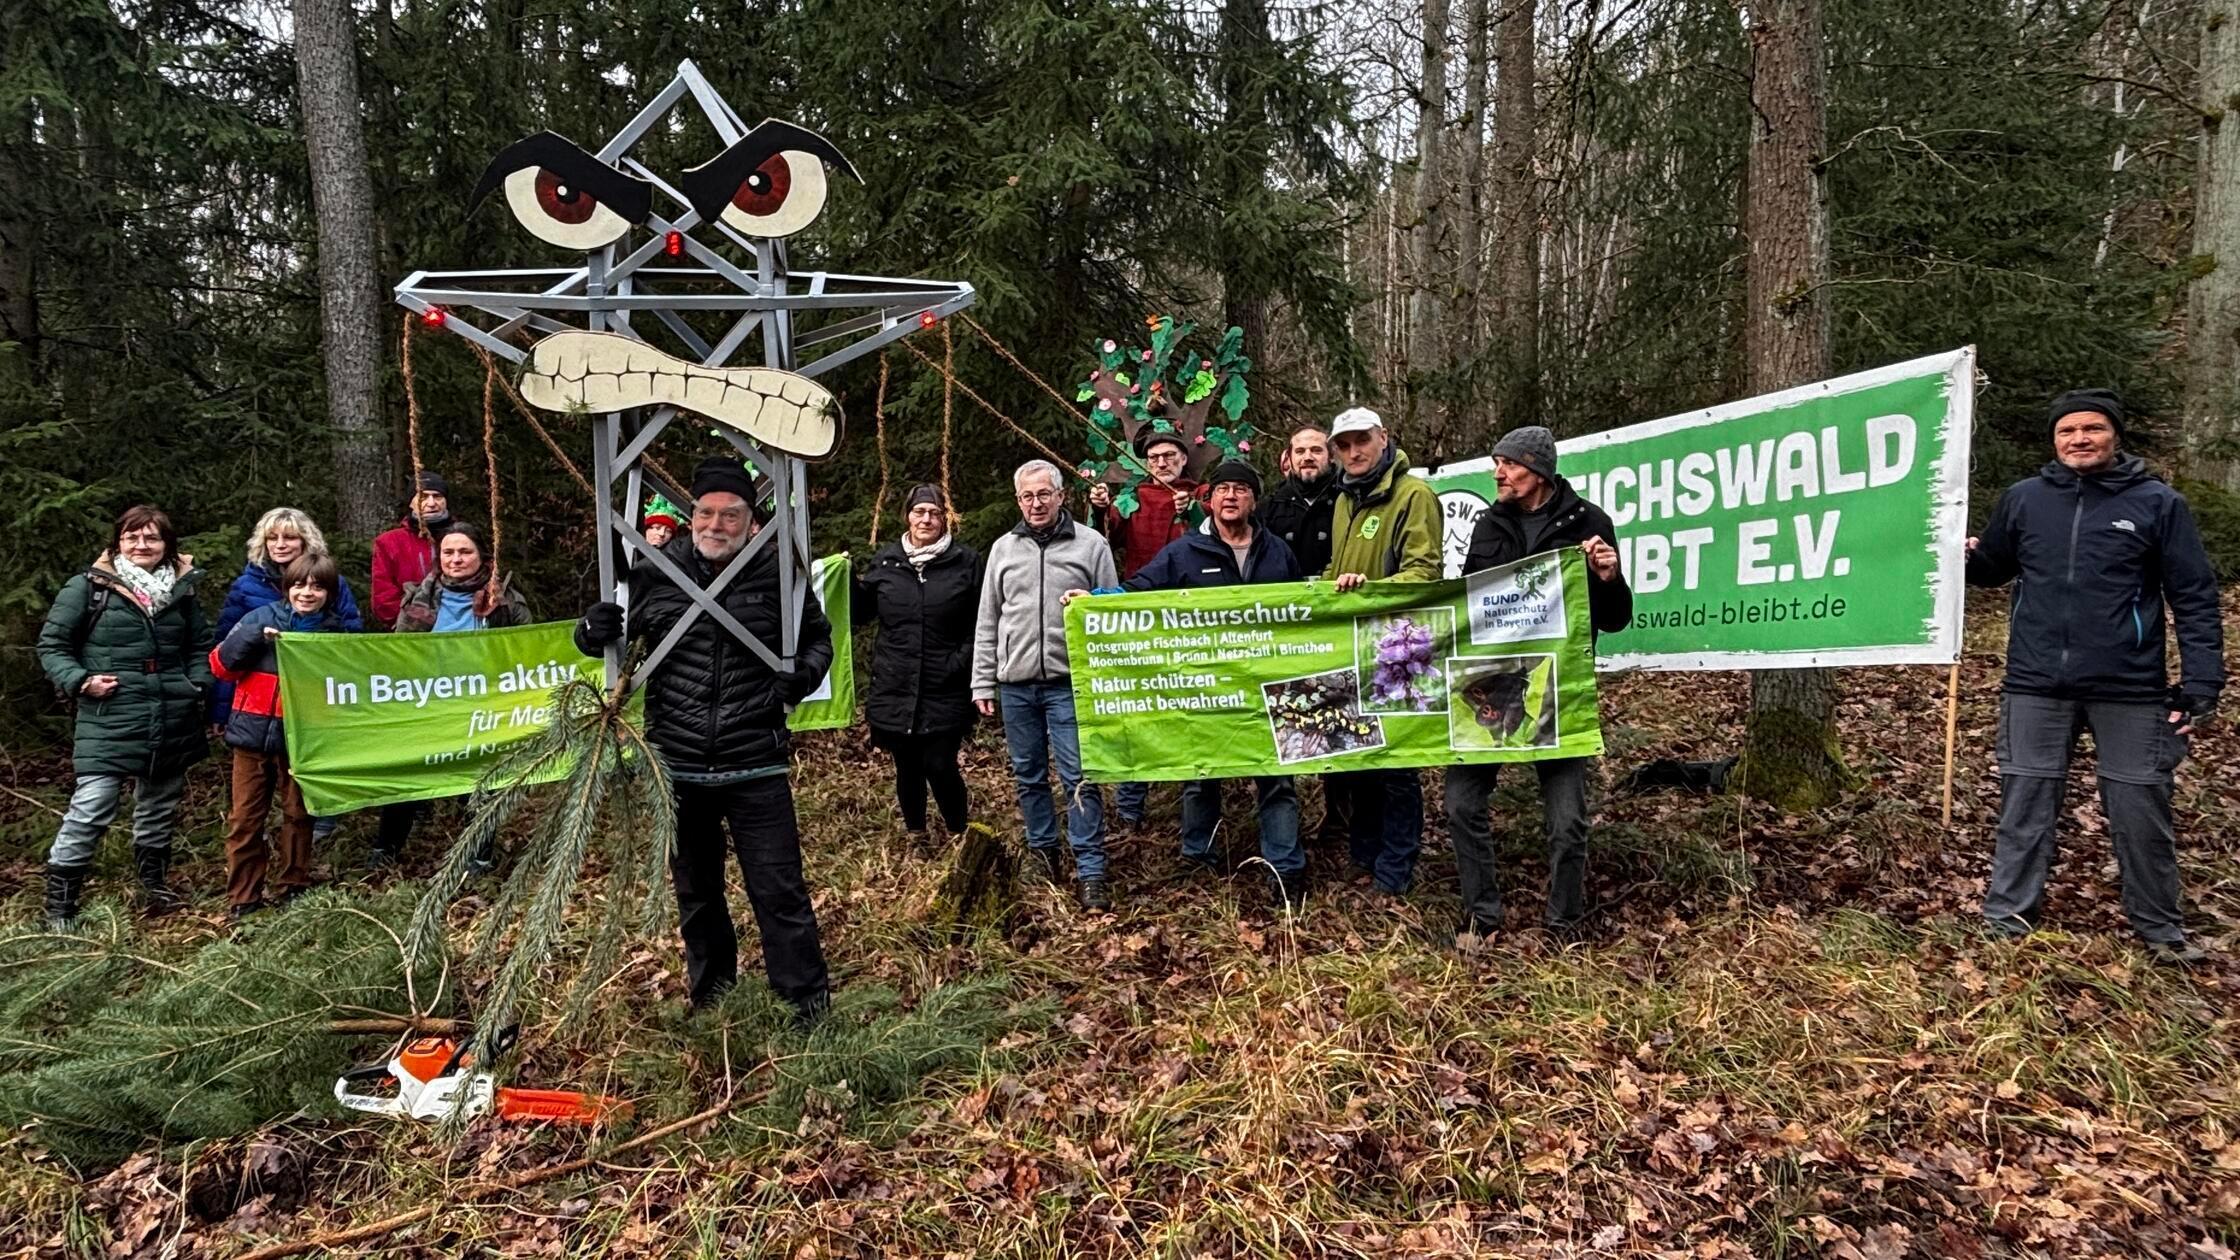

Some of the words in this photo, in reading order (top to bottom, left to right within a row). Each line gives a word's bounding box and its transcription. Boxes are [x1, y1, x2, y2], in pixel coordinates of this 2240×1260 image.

[1567, 414, 1918, 527] ICHSWALD
[1620, 526, 1714, 594] IBT
[1737, 510, 1851, 586] E.V.
[1483, 593, 1520, 607] BUND
[1484, 604, 1548, 619] Naturschutz
[1084, 609, 1155, 635] BUND
[1161, 602, 1313, 630] Naturschutz
[1496, 617, 1531, 629] Bayern
[1533, 614, 1549, 626] e.V.
[1086, 639, 1151, 654] Ortsgruppe
[1152, 632, 1211, 649] Fischbach
[1220, 629, 1274, 645] Altenfurt
[1088, 653, 1164, 669] Moorenbrunn
[1279, 641, 1334, 656] Birnthon
[325, 676, 358, 706] In
[370, 673, 488, 709] Bayern
[498, 659, 578, 693] aktiv
[1091, 675, 1137, 694] Natur
[1141, 672, 1216, 691] schützen
[1094, 696, 1154, 715] Heimat
[1156, 689, 1246, 711] bewahren!
[467, 708, 505, 738] für
[508, 703, 554, 727] Me
[425, 743, 472, 766] und
